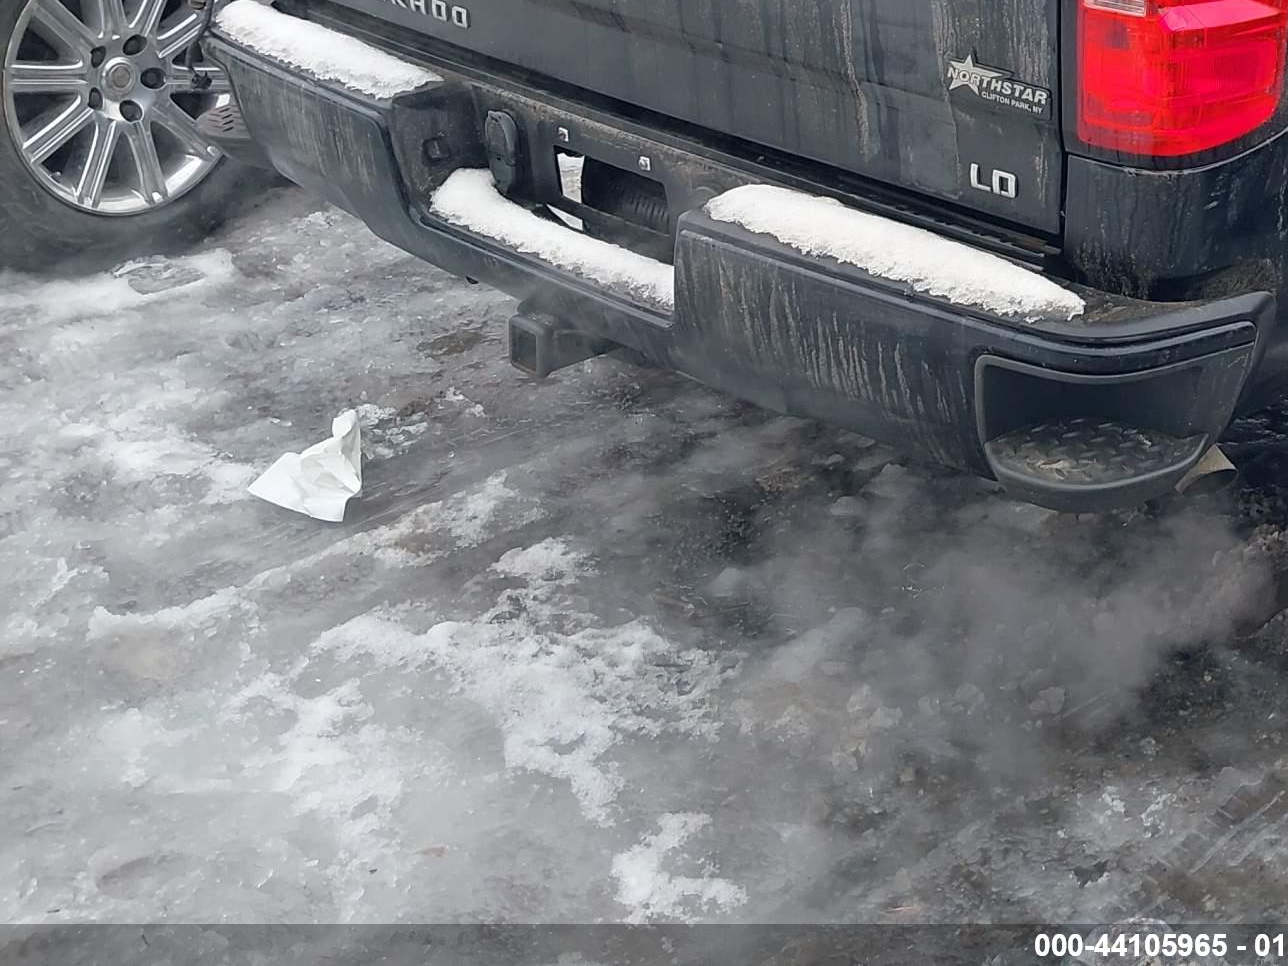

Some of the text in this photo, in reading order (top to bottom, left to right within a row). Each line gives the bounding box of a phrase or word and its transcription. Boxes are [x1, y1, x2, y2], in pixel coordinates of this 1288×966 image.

[947, 66, 1049, 105] NORTHSTAR
[981, 91, 1043, 114] CLIFTON PARK, NY
[970, 162, 1016, 199] LD
